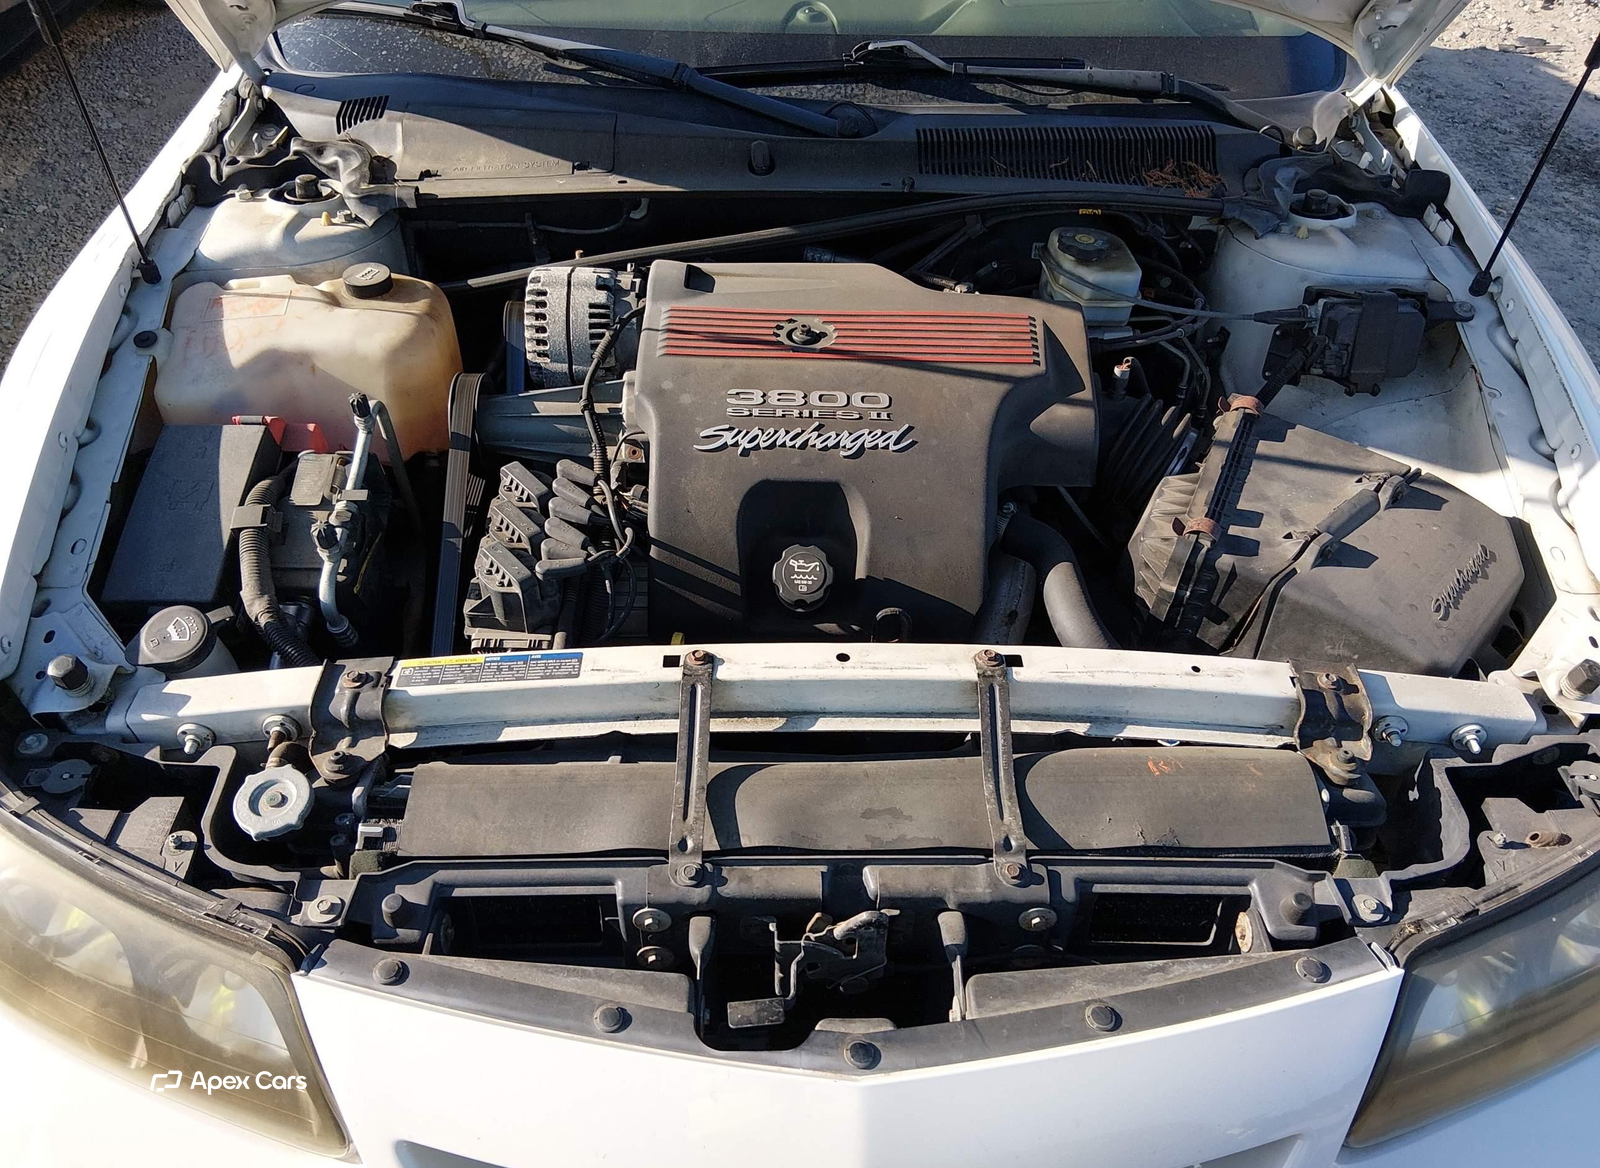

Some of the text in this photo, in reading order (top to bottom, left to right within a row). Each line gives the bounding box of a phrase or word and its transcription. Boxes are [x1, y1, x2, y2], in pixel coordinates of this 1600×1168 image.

[726, 388, 892, 409] 3800
[726, 407, 893, 421] SERIES II
[693, 421, 916, 459] Supercharged
